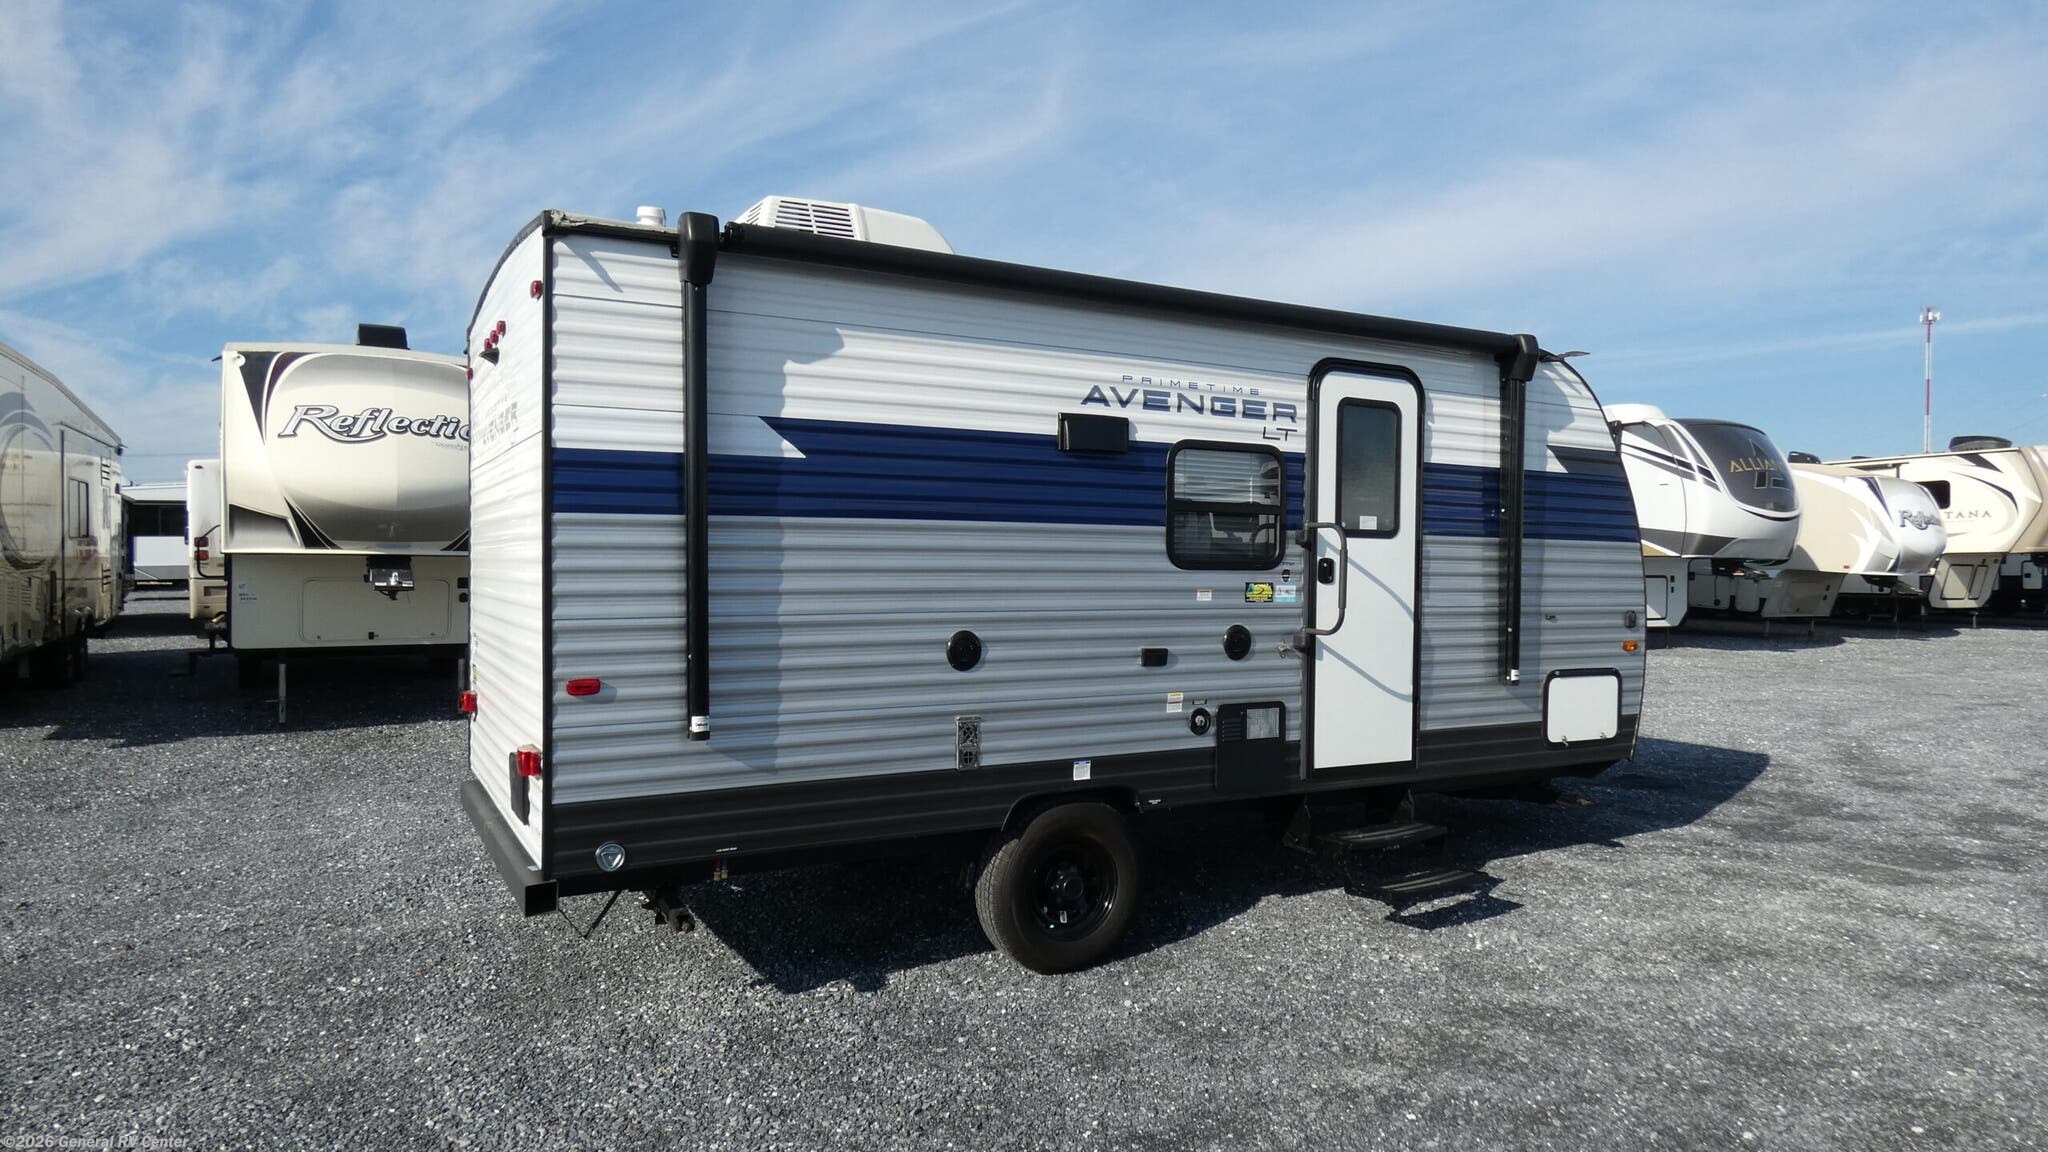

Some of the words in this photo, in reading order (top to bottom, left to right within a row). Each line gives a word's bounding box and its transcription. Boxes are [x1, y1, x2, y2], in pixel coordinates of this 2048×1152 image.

[1122, 374, 1260, 396] PRIMETIME
[1080, 384, 1298, 424] AVENGER
[278, 404, 471, 444] Reflectio
[1262, 426, 1298, 441] LT
[1944, 510, 1992, 519] TANA
